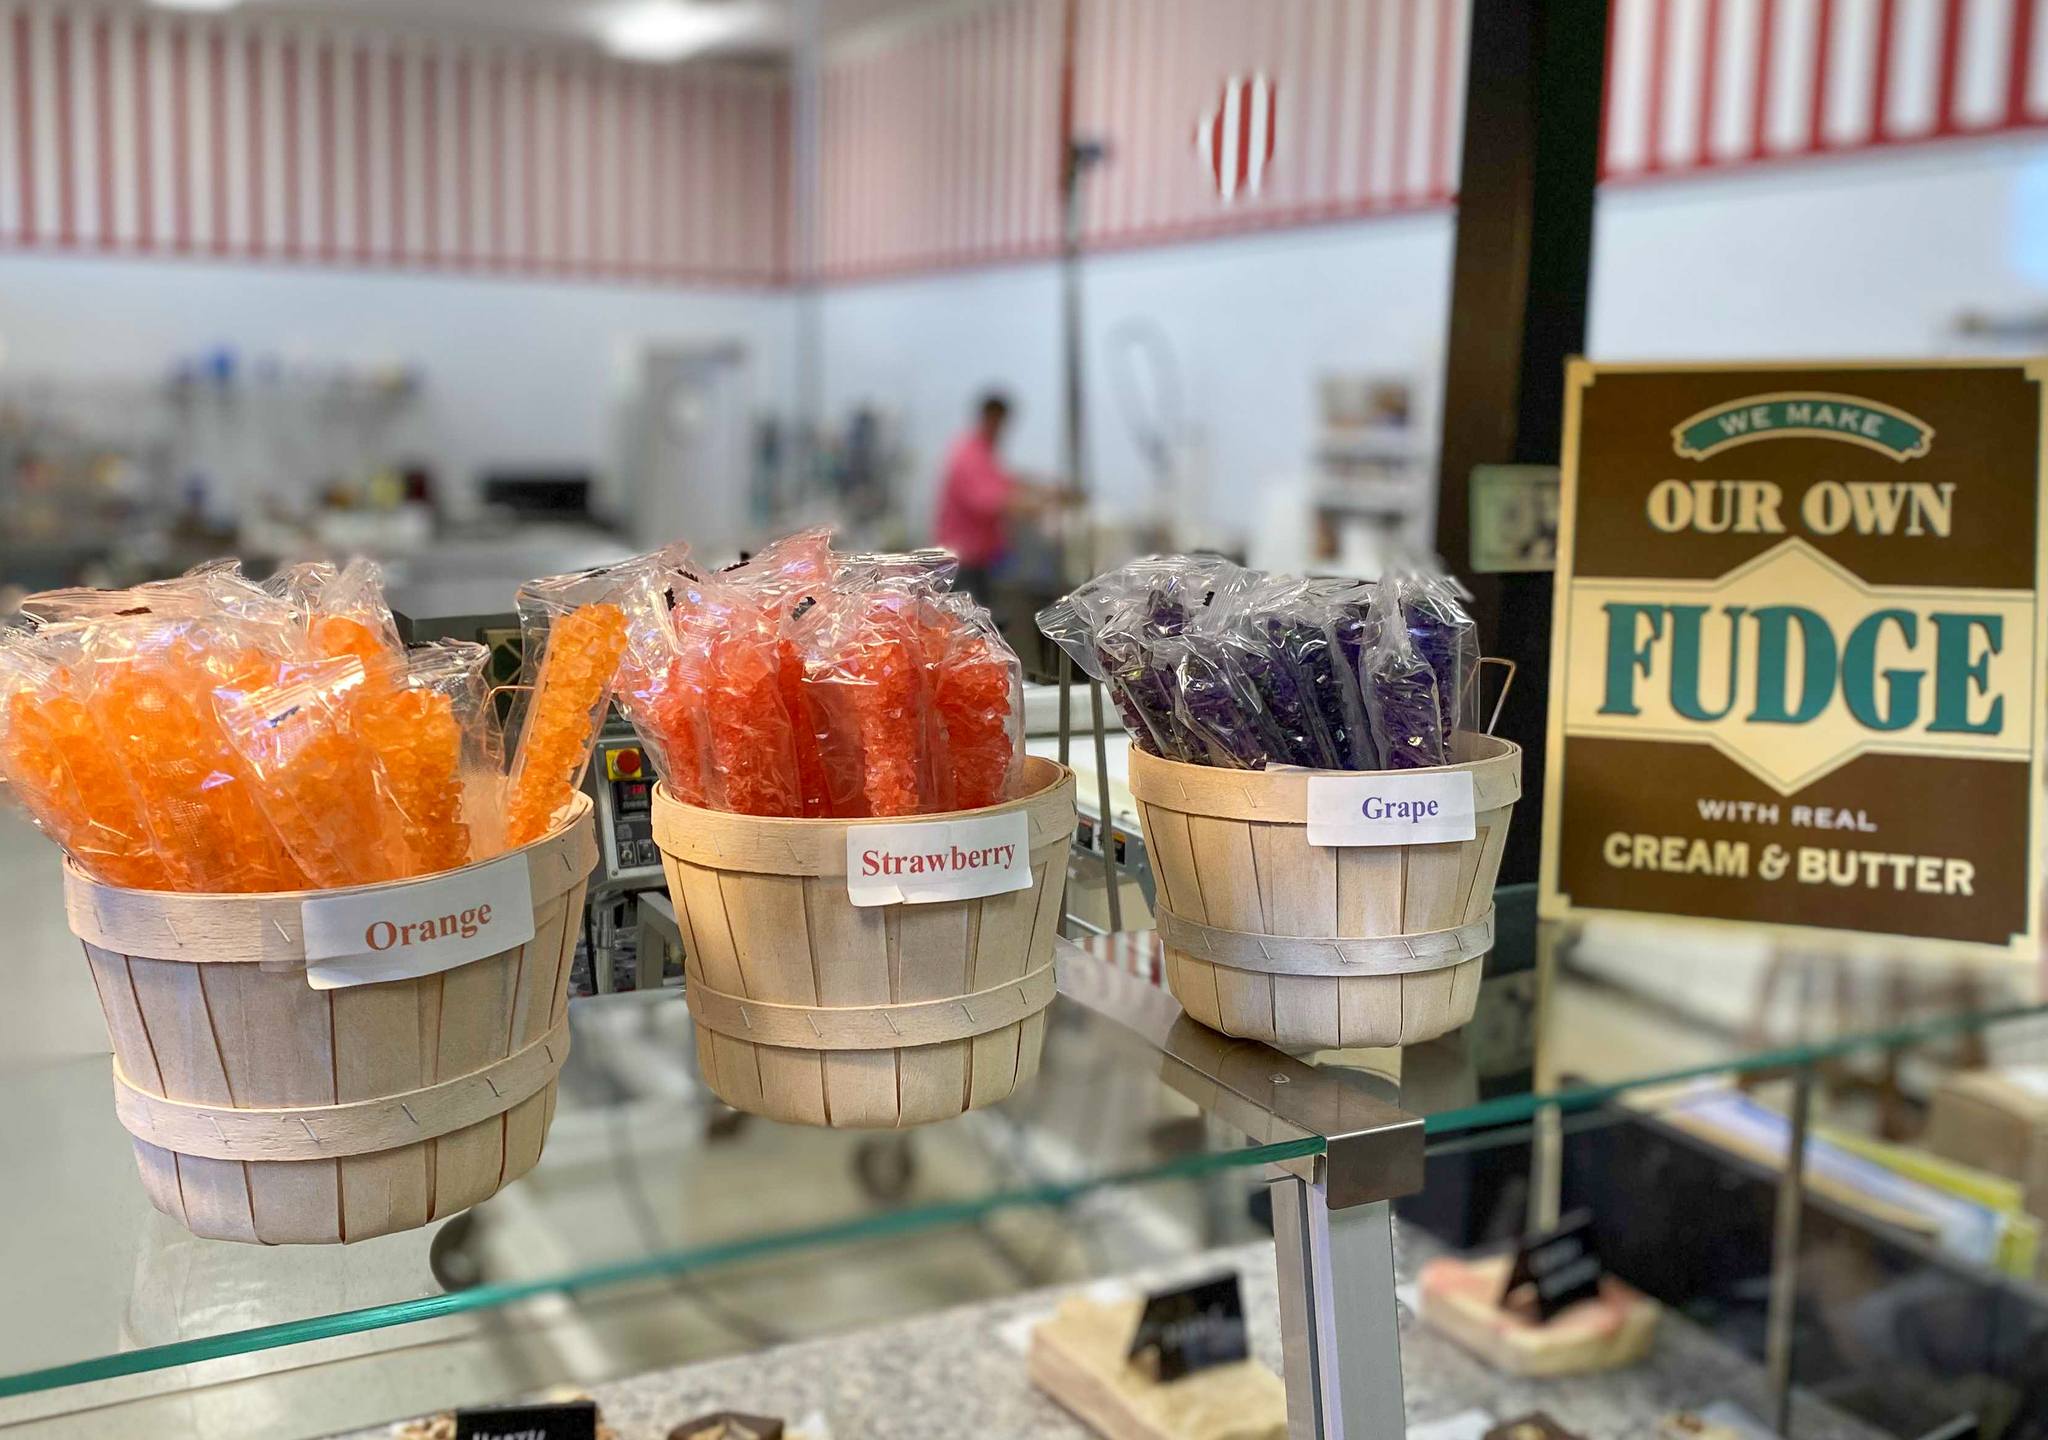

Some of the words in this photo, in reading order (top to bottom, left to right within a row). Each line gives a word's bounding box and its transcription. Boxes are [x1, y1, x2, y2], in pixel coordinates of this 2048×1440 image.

[1717, 405, 1772, 436] WE
[1785, 403, 1886, 438] MAKE
[1646, 479, 1787, 533] OUR
[1802, 480, 1957, 537] OWN
[1597, 602, 2005, 736] FUDGE
[1361, 796, 1439, 824] Grape
[1697, 798, 1780, 825] WITH
[1790, 804, 1878, 833] REAL
[862, 843, 1016, 877] Strawberry
[1603, 832, 1750, 879] CREAM
[1757, 842, 1791, 882] &
[1796, 846, 1975, 896] BUTTER
[365, 903, 492, 951] Orange
